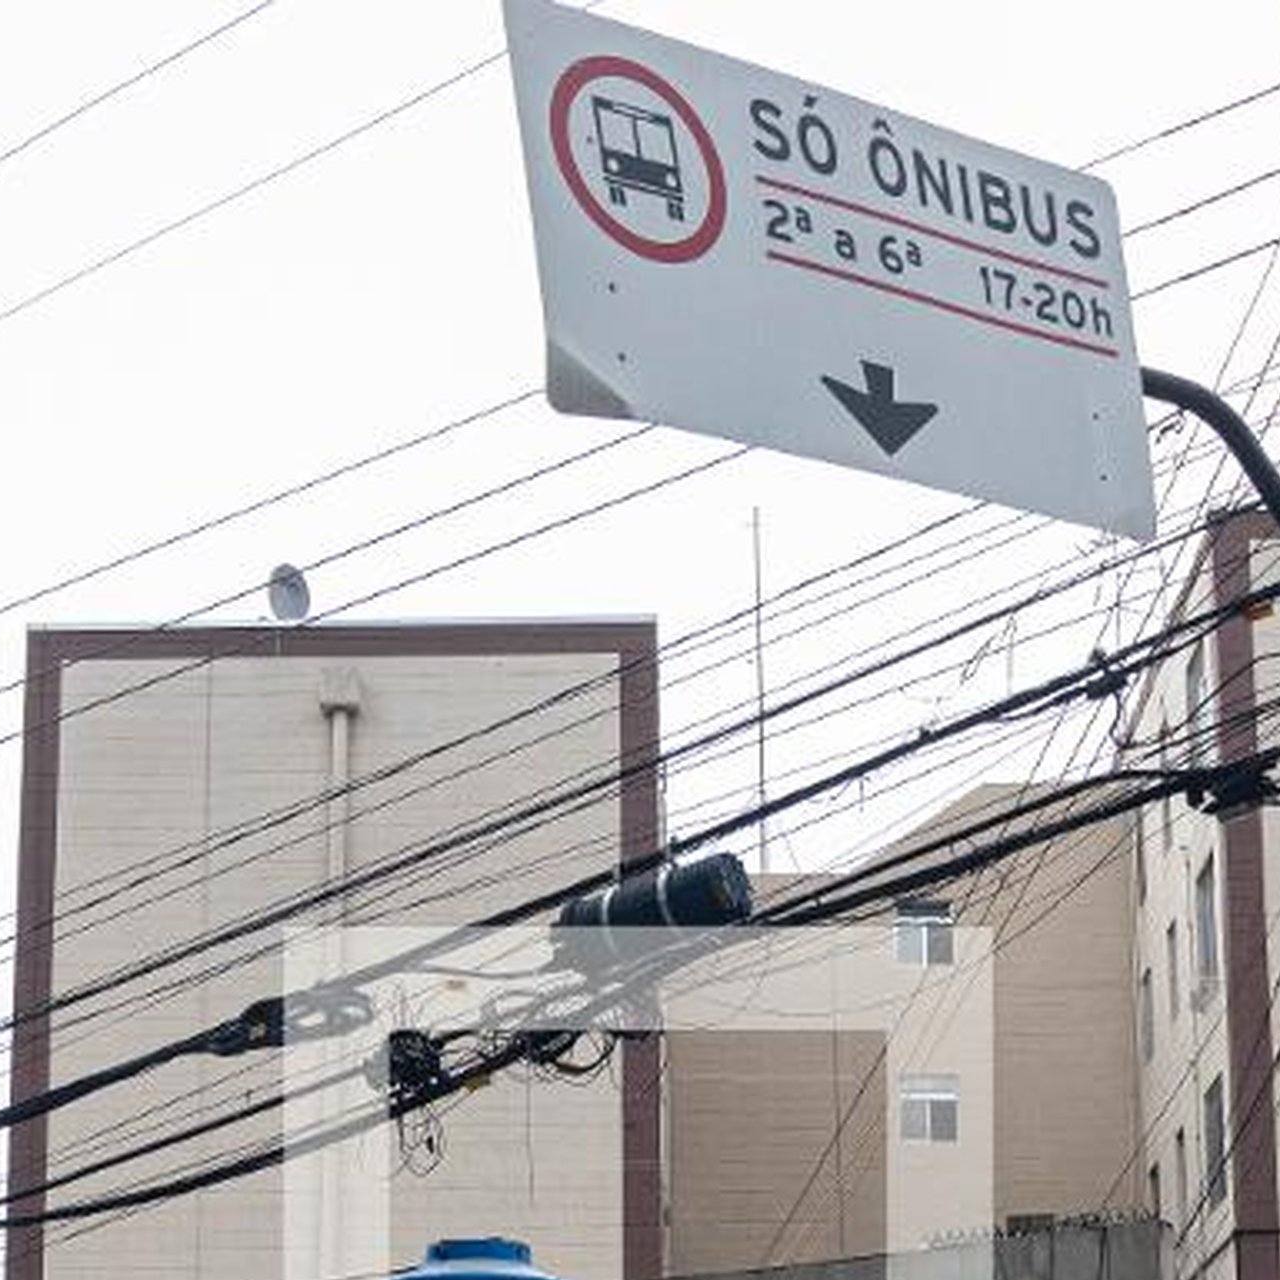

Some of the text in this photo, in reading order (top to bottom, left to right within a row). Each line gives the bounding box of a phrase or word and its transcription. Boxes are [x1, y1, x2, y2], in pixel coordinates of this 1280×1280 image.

[748, 94, 1102, 259] SÓ ÔNIBUS
[833, 229, 857, 261] a
[979, 266, 1114, 337] 17-20h
